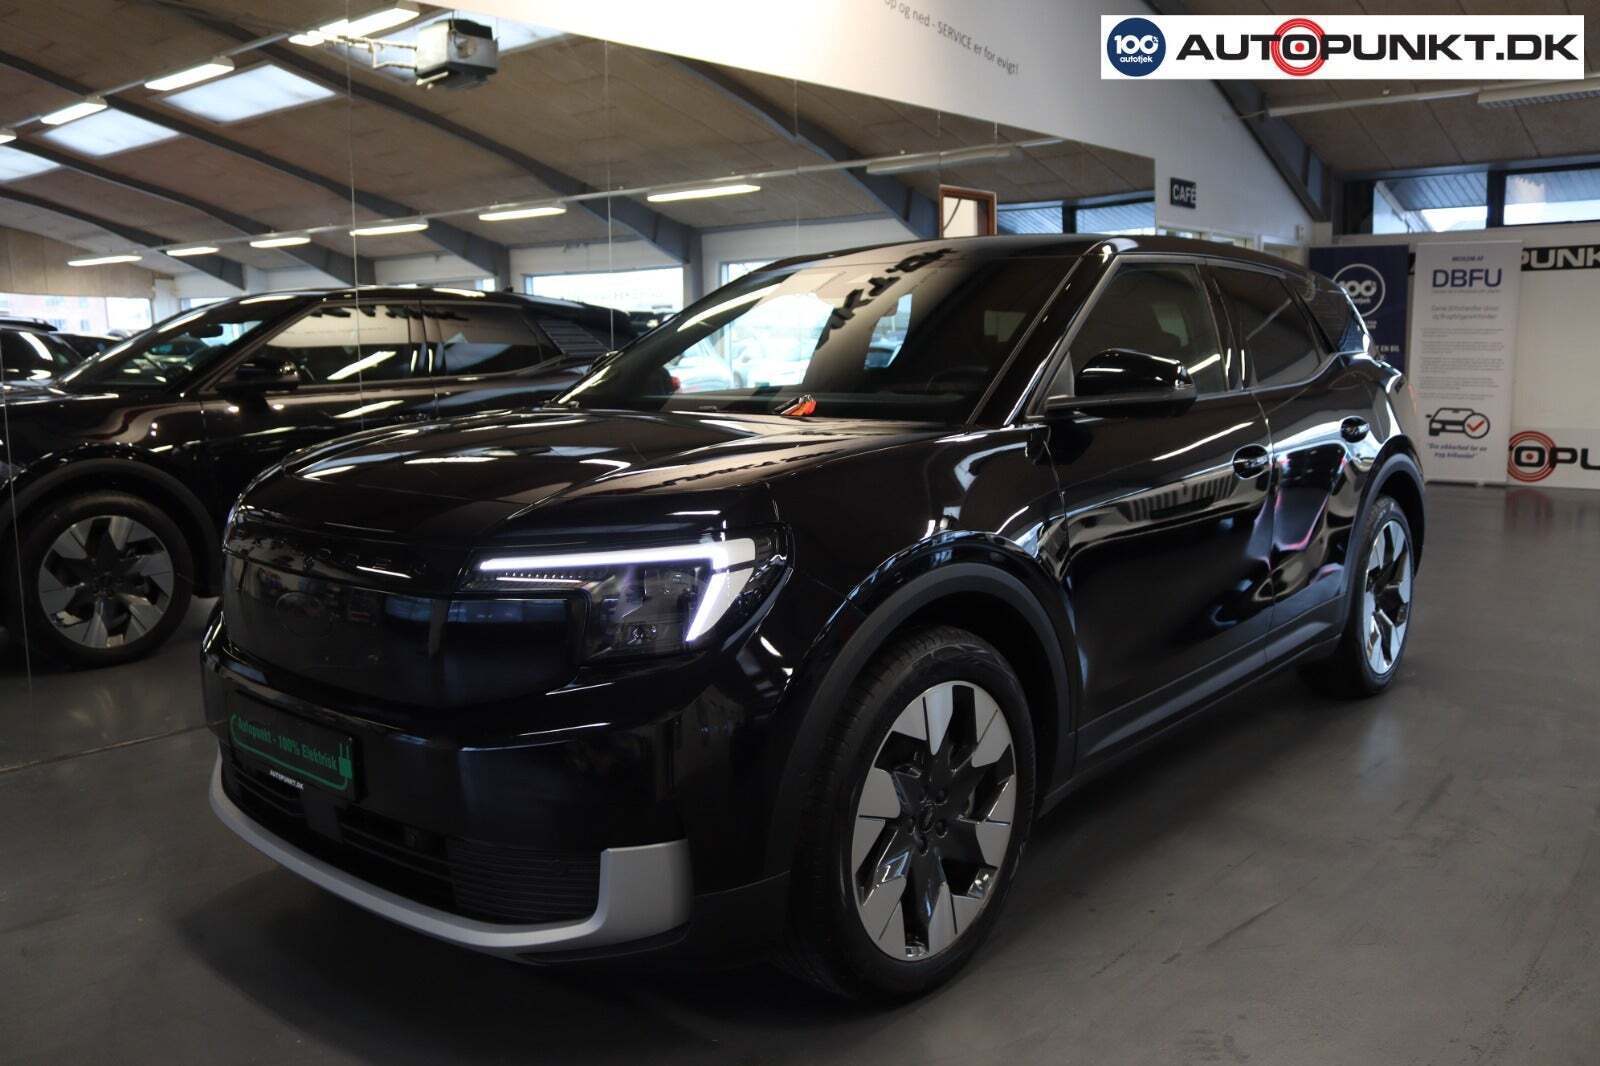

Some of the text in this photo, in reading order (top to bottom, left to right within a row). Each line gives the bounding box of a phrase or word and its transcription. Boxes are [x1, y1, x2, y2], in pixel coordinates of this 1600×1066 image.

[899, 4, 911, 20] og
[912, 10, 931, 27] ned
[937, 20, 972, 50] SERVICE
[973, 43, 982, 55] er
[984, 46, 996, 62] for
[996, 55, 1019, 75] evigt!
[1431, 268, 1503, 288] DBFU
